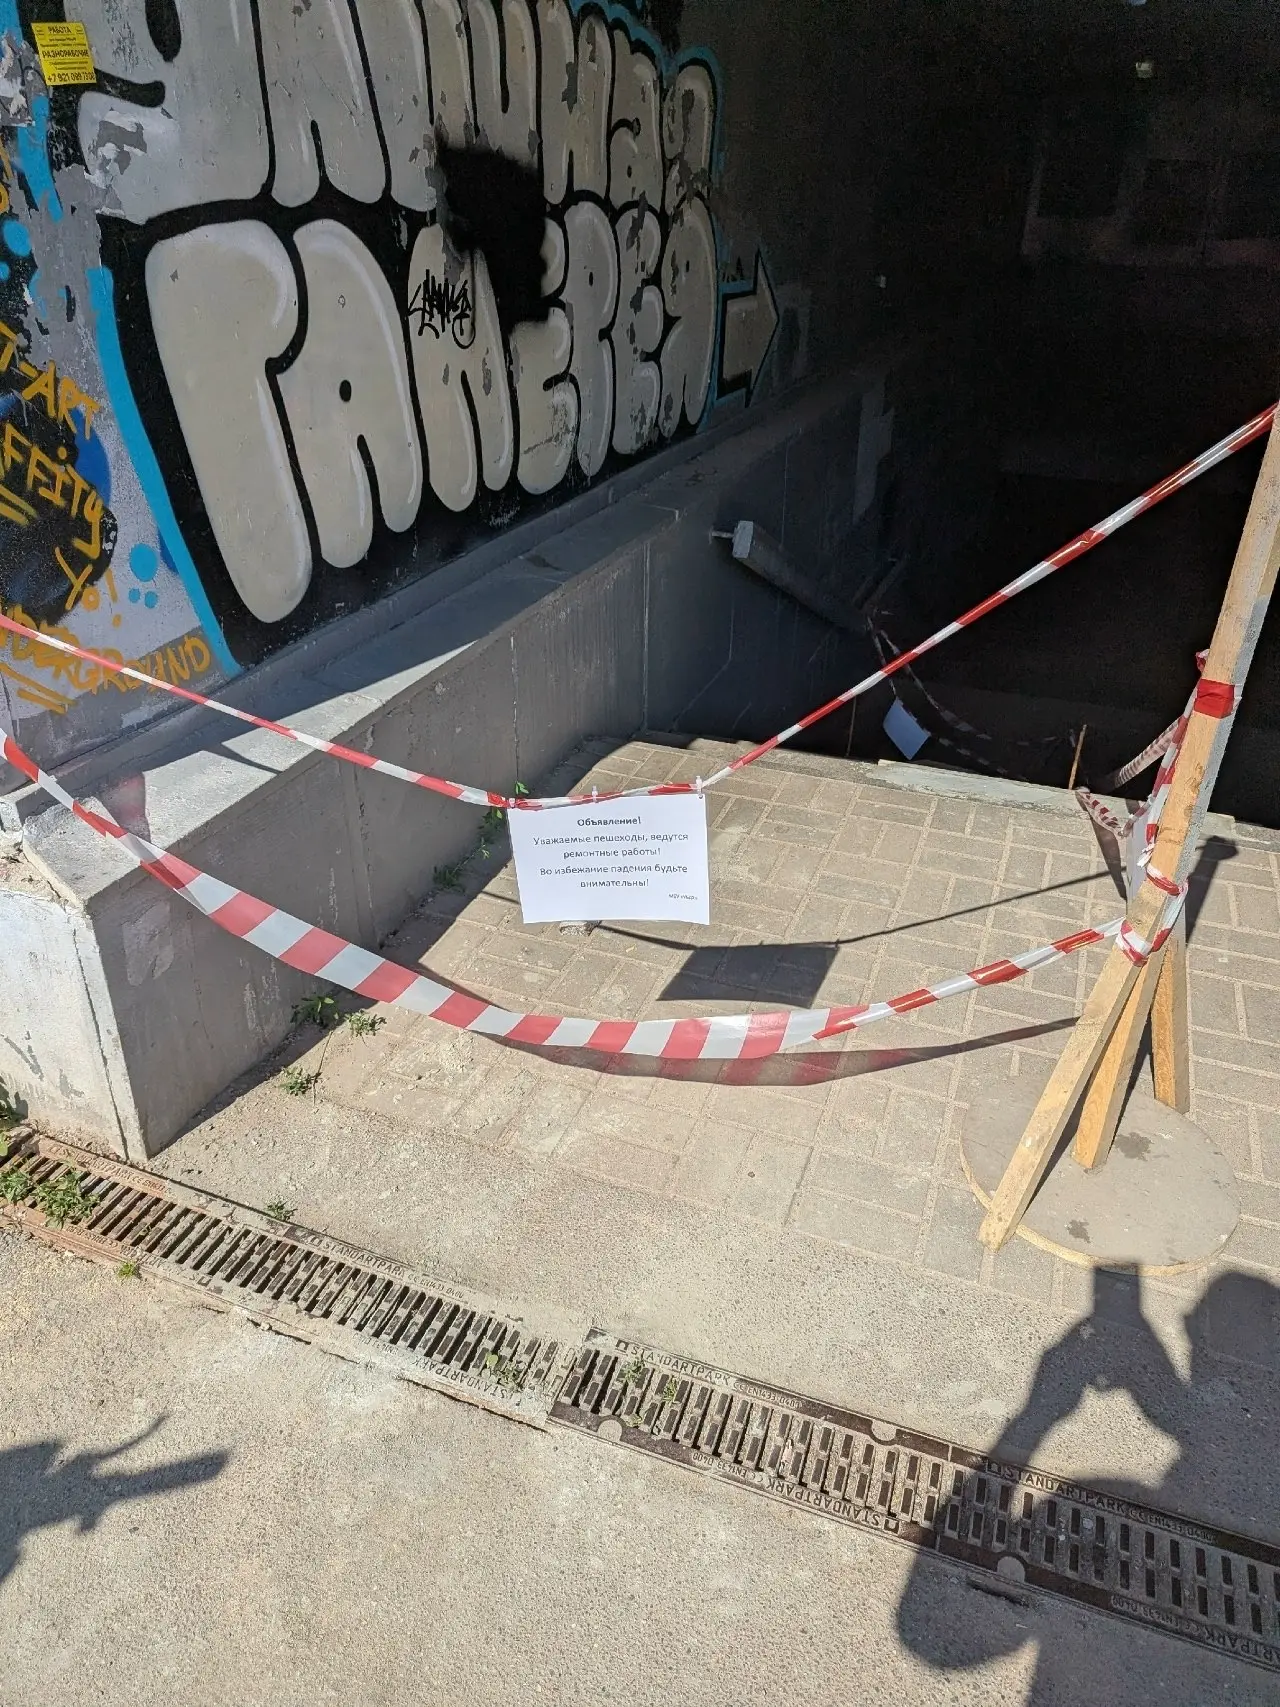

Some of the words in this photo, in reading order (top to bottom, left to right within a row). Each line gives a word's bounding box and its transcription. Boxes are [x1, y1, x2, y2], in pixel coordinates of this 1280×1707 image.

[48, 26, 72, 34] РАБОТА
[577, 816, 641, 827] Объявление!
[533, 836, 591, 846] Уважаемые
[593, 834, 648, 844] пешеходы,
[651, 833, 689, 843] ведутся
[563, 849, 619, 859] ремонтные
[621, 847, 661, 858] работы!
[540, 867, 552, 876] Во
[554, 865, 609, 875] избежание
[611, 864, 652, 874] падения
[654, 862, 688, 874] будьте
[580, 878, 649, 889] внимательны!
[631, 1345, 730, 1386] STANDARTPARK
[1006, 1465, 1126, 1514] STANDARTPARK
[765, 1477, 881, 1526] STANDARTPARK
